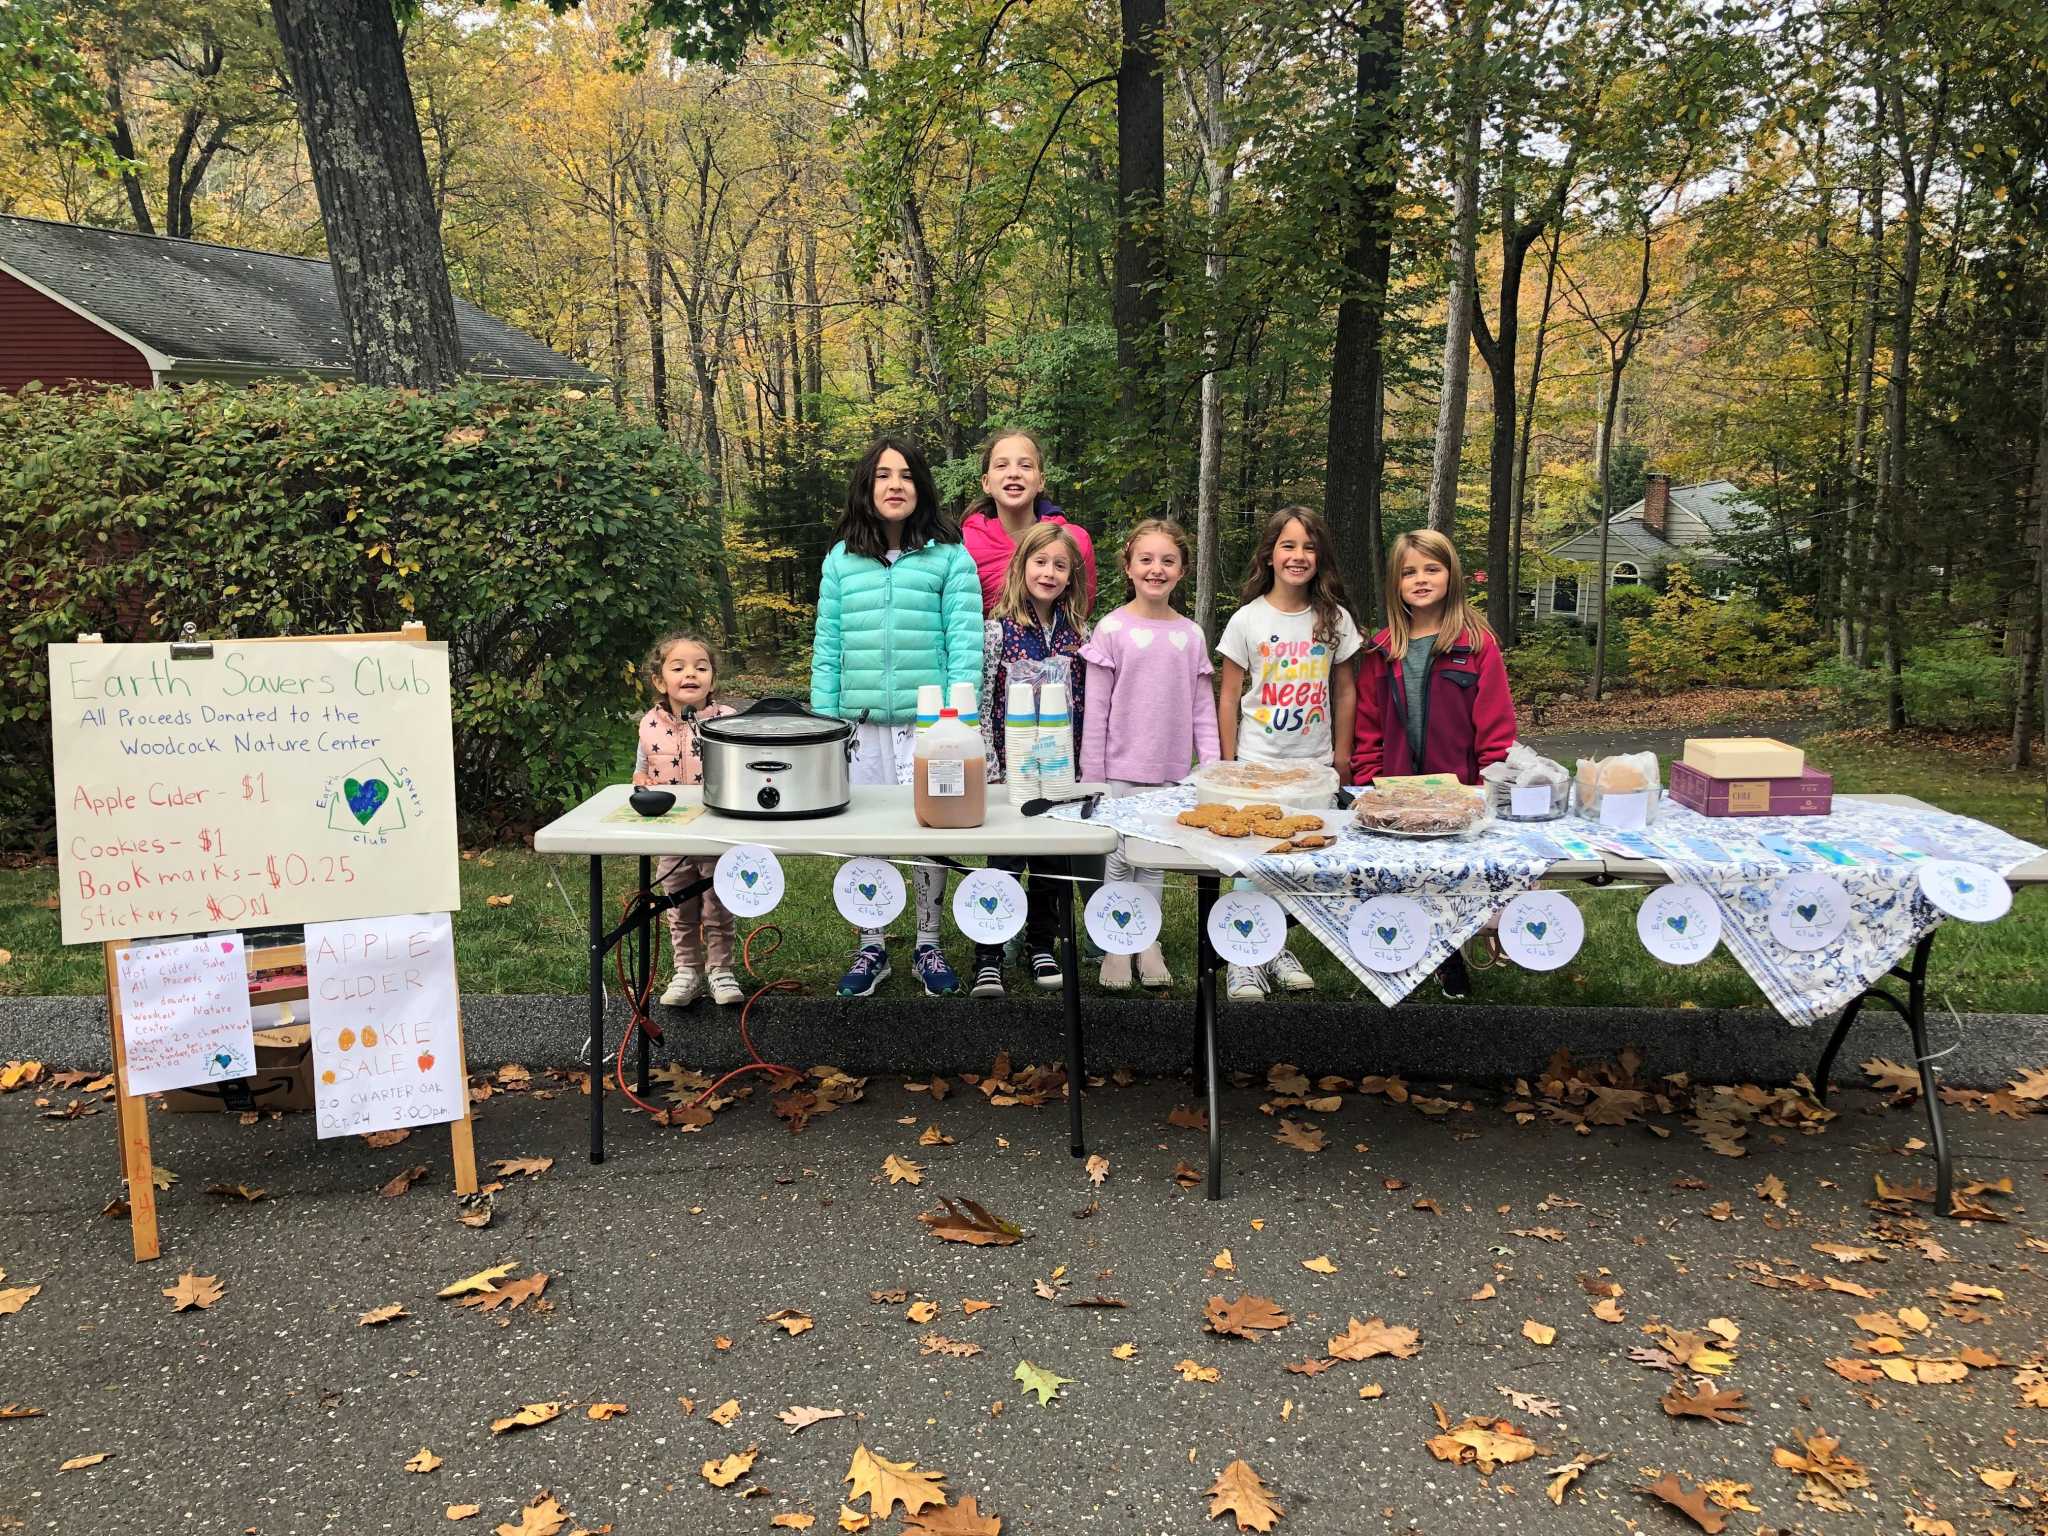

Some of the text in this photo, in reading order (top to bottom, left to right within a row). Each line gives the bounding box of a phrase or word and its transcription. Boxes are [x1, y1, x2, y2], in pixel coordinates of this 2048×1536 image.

[1275, 641, 1309, 657] OUR
[70, 652, 431, 700] Earth Savers Club
[1261, 681, 1327, 706] Needs
[80, 704, 361, 728] All Proceeds Donated to the
[1273, 708, 1303, 732] US
[119, 734, 382, 755] Woodcock Nature Center
[73, 785, 136, 816] Apple
[241, 772, 270, 804] $1
[198, 827, 227, 859] $1
[265, 853, 355, 889] $0.25
[316, 931, 431, 964] APPLE
[131, 981, 148, 993] All
[319, 969, 424, 1000] CIDER
[315, 1021, 432, 1054] COOKIE
[338, 1053, 408, 1081] SALE
[319, 1083, 443, 1109] 20 CHARTER OAK
[352, 1112, 370, 1125] 24
